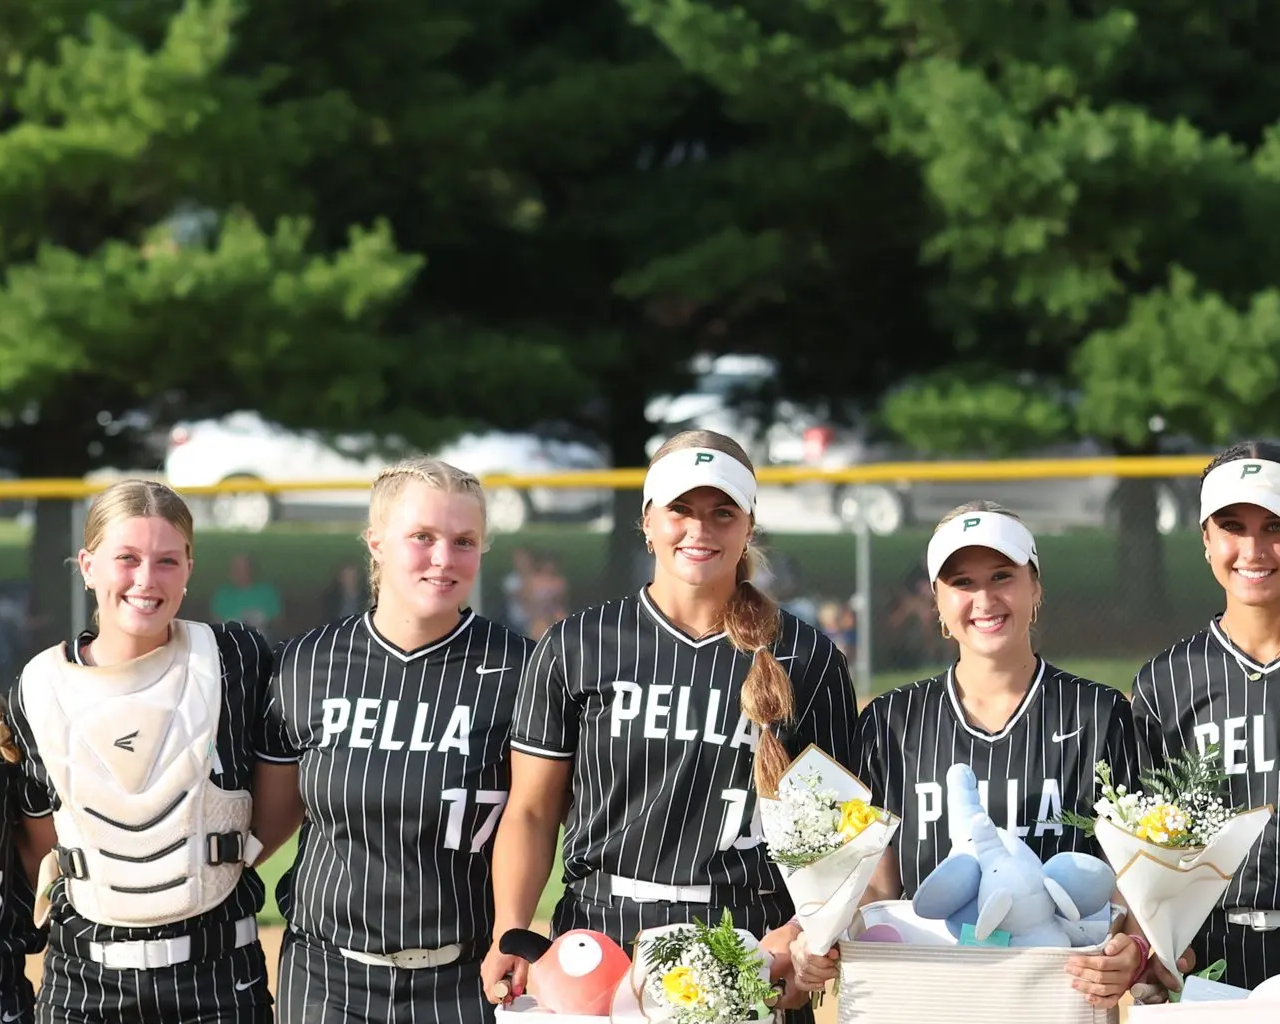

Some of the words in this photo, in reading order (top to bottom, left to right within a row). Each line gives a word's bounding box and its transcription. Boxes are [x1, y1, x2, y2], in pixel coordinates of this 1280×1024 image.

[694, 452, 715, 466] P
[1240, 464, 1262, 479] P
[963, 517, 981, 532] P
[319, 697, 470, 757] PELLA
[610, 681, 760, 753] PELLA
[441, 787, 508, 853] 17
[915, 778, 1064, 841] PLA
